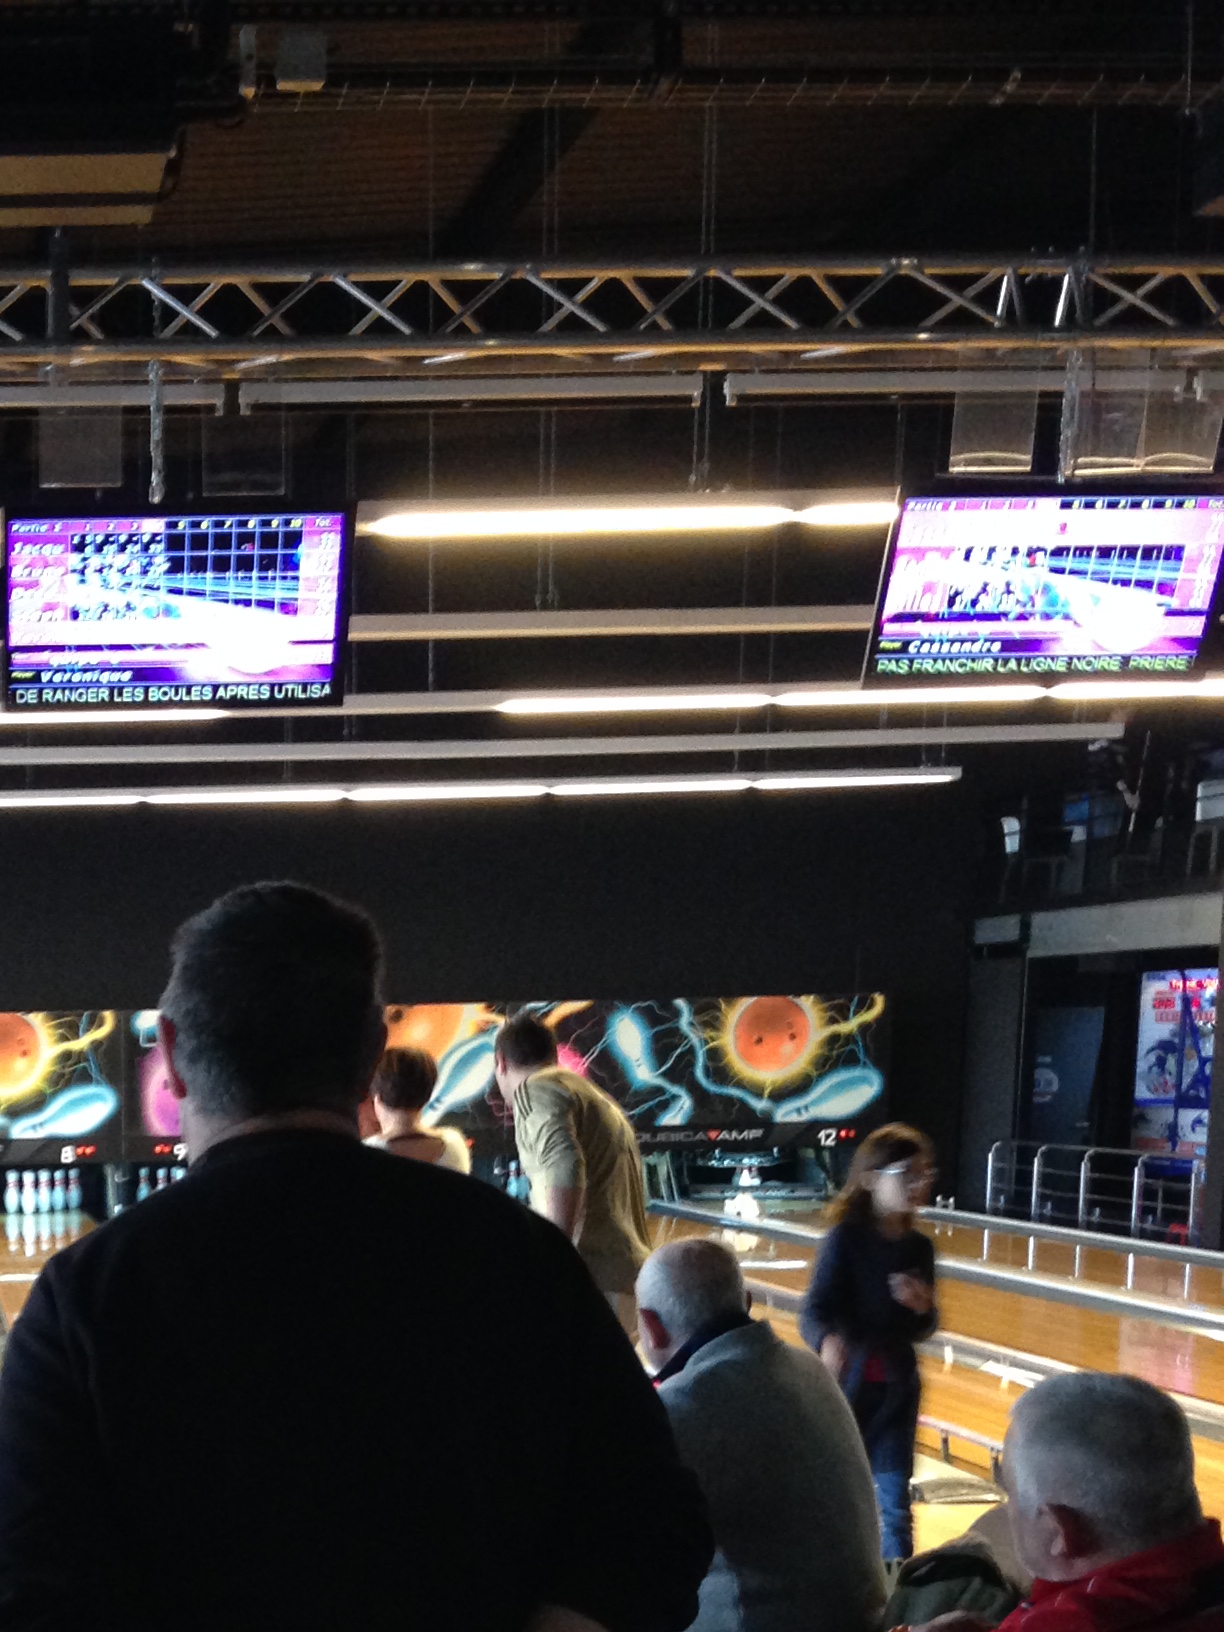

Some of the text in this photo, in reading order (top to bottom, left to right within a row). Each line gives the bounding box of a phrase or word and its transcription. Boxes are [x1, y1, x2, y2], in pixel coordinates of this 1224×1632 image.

[875, 654, 1189, 676] PAS FRANCHIR LA LIGNE NOIRE PRIERE
[15, 688, 39, 704] DE
[42, 687, 110, 703] RANGER
[113, 686, 145, 702] LES
[148, 685, 213, 702] BOULES
[215, 684, 271, 701] APRES
[816, 1128, 837, 1147] 12
[60, 1145, 76, 1163] 8
